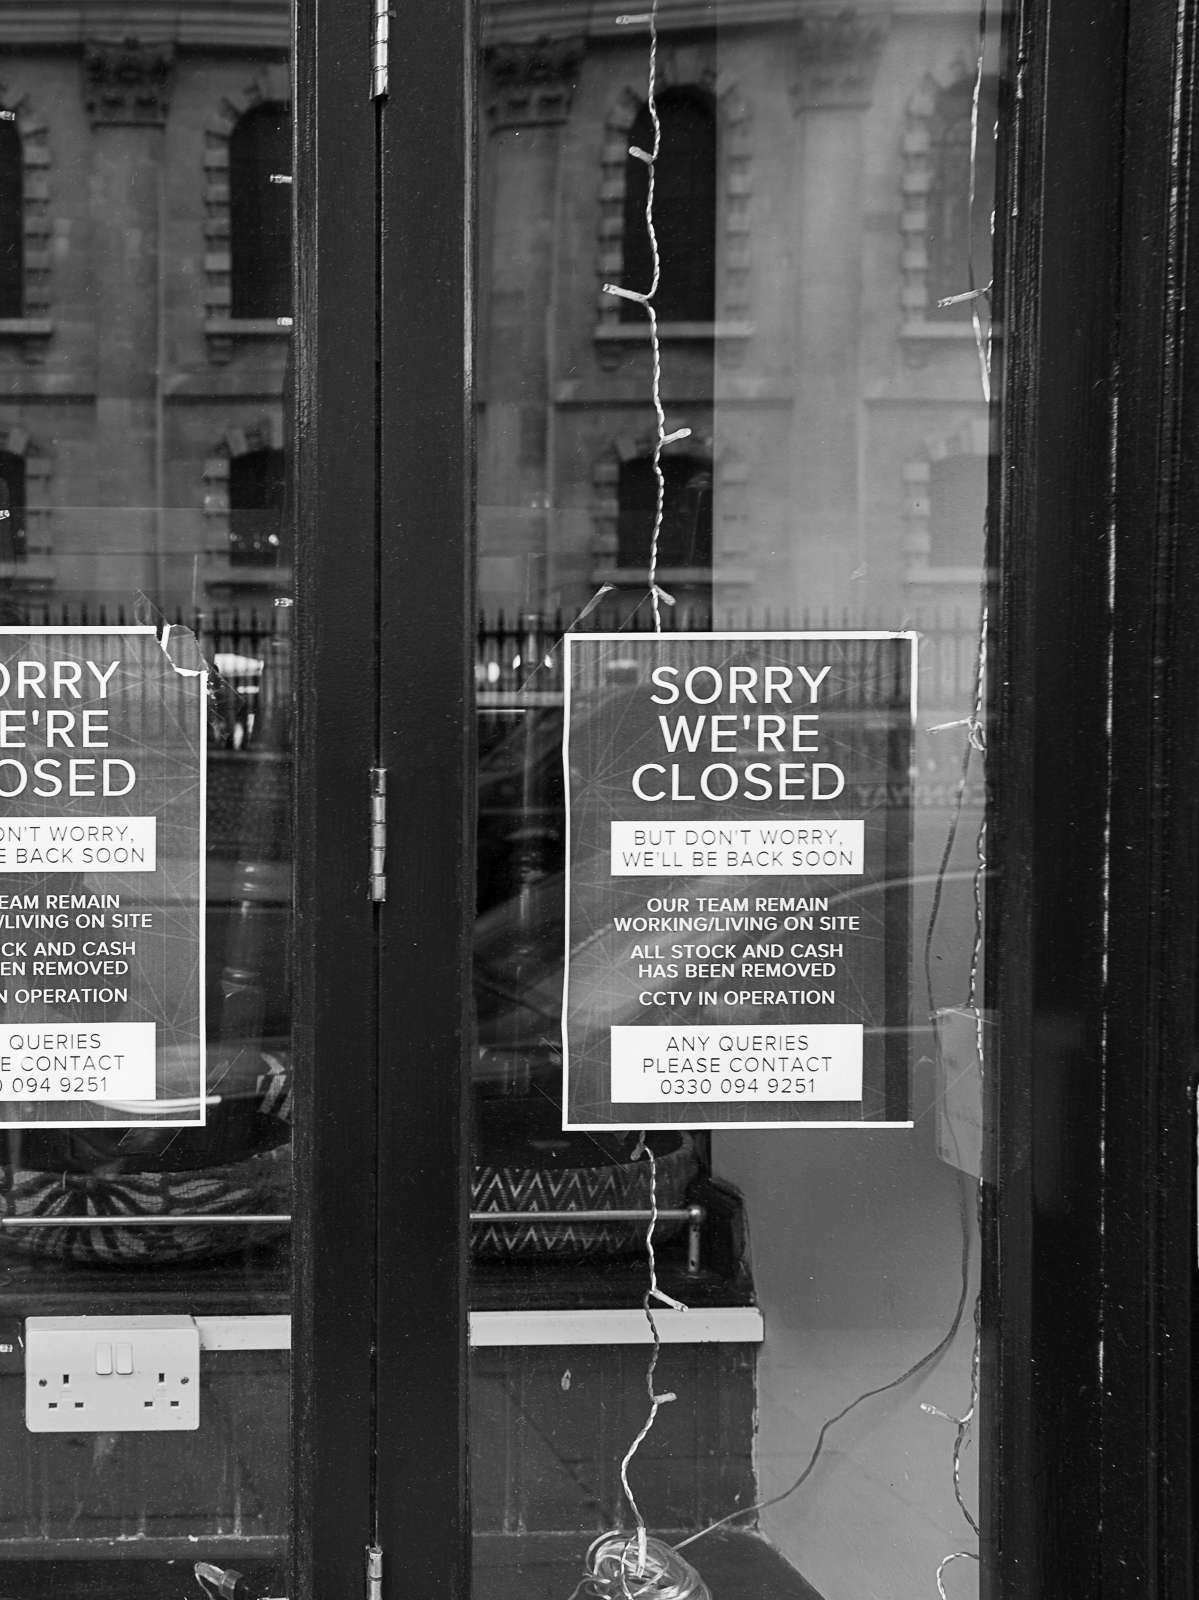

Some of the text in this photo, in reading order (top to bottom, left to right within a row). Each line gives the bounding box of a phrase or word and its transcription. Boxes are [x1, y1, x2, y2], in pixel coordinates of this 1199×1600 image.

[650, 665, 832, 705] SORRY
[658, 714, 819, 753] WE'RE
[631, 762, 845, 802] CLOSED
[49, 826, 134, 845] WORRY,
[634, 830, 843, 847] BUT DON'T WORRY,
[16, 847, 73, 864] BACK
[82, 847, 144, 863] SOON
[622, 851, 853, 867] WE'LL BE BACK SOON
[46, 894, 120, 910] REMAIN
[646, 897, 828, 914] OUR TEAM REMAIN
[75, 914, 105, 930] ON
[112, 913, 152, 929] SITE
[613, 916, 860, 933] WORKING/LIVING ON SITE
[34, 942, 76, 957] AND
[82, 941, 135, 957] CASH
[630, 943, 843, 960] ALL STOCK AND CASH
[33, 960, 128, 976] REMOVED
[638, 962, 836, 979] HAS BEEN REMOVED
[15, 988, 128, 1004] OPERATION
[639, 990, 835, 1007] CCTV IN OPERATION
[9, 1033, 101, 1050] QUERIES
[666, 1035, 809, 1052] ANY QUERIES
[21, 1055, 124, 1072] CONTACT
[643, 1057, 832, 1074] PLEASE CONTACT
[12, 1077, 52, 1094] 094
[59, 1076, 107, 1093] 9251
[661, 1078, 815, 1095] 0330 094 9251
